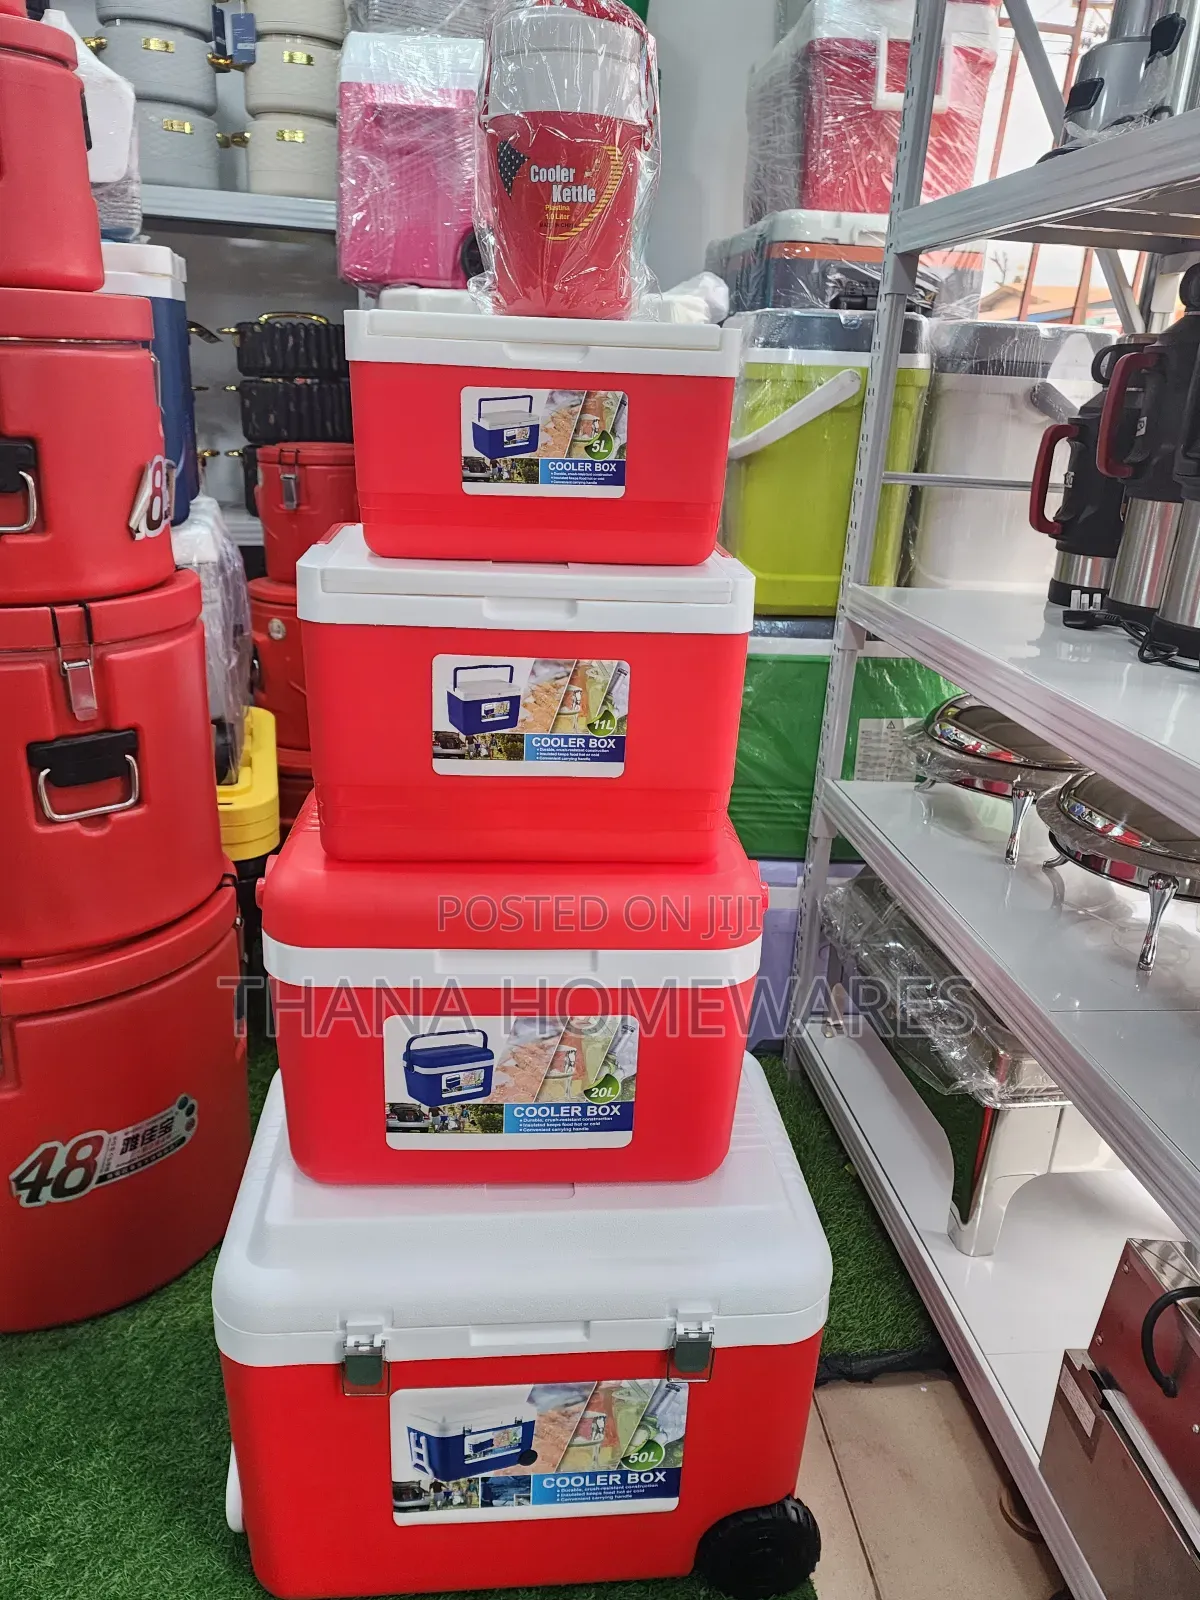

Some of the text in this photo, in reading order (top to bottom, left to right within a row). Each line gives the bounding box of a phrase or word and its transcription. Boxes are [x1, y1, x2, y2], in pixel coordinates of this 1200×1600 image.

[530, 164, 576, 182] Cooler
[552, 184, 597, 203] Kettle
[592, 440, 609, 453] 5L
[548, 461, 617, 472] COOLER BOX
[593, 719, 614, 730] 11L
[532, 737, 616, 748] COOLER BOX
[590, 1087, 616, 1098] 20L
[514, 1104, 621, 1118] COOLER BOX
[12, 1134, 105, 1204] 48
[628, 1451, 660, 1464] 50L
[542, 1471, 667, 1489] COOLER BOX
